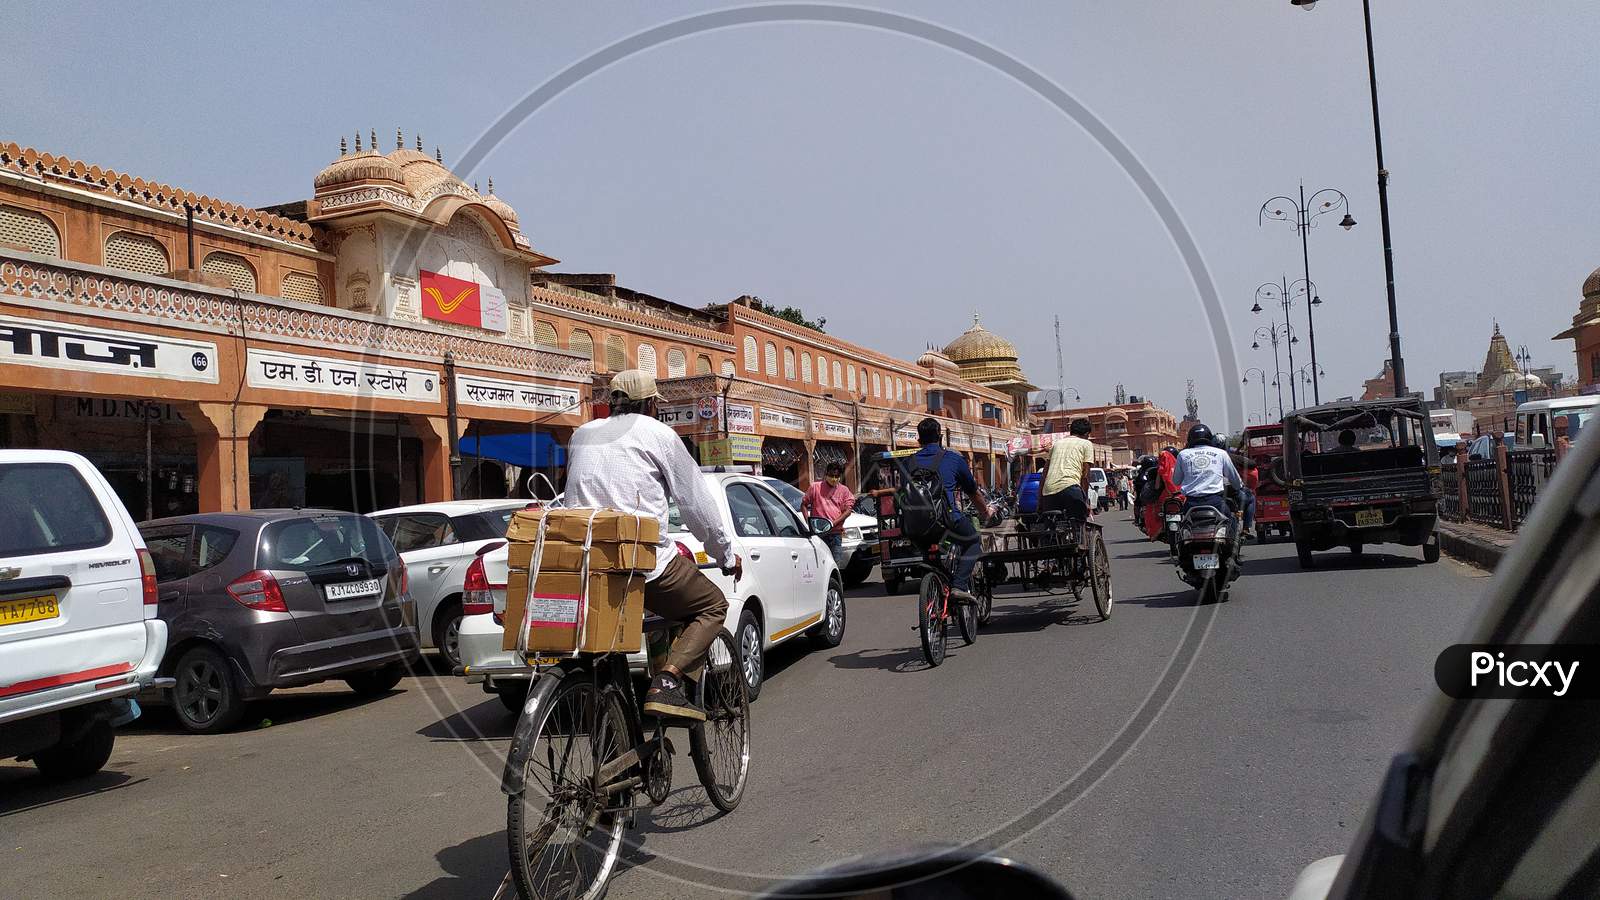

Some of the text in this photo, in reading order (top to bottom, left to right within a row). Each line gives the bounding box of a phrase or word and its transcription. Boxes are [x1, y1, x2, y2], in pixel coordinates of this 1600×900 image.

[193, 356, 207, 367] 166
[260, 361, 407, 393] एम. डी. एन. स्टोर्स
[466, 384, 514, 402] सूरजमल
[520, 390, 561, 407] रामप्रताप
